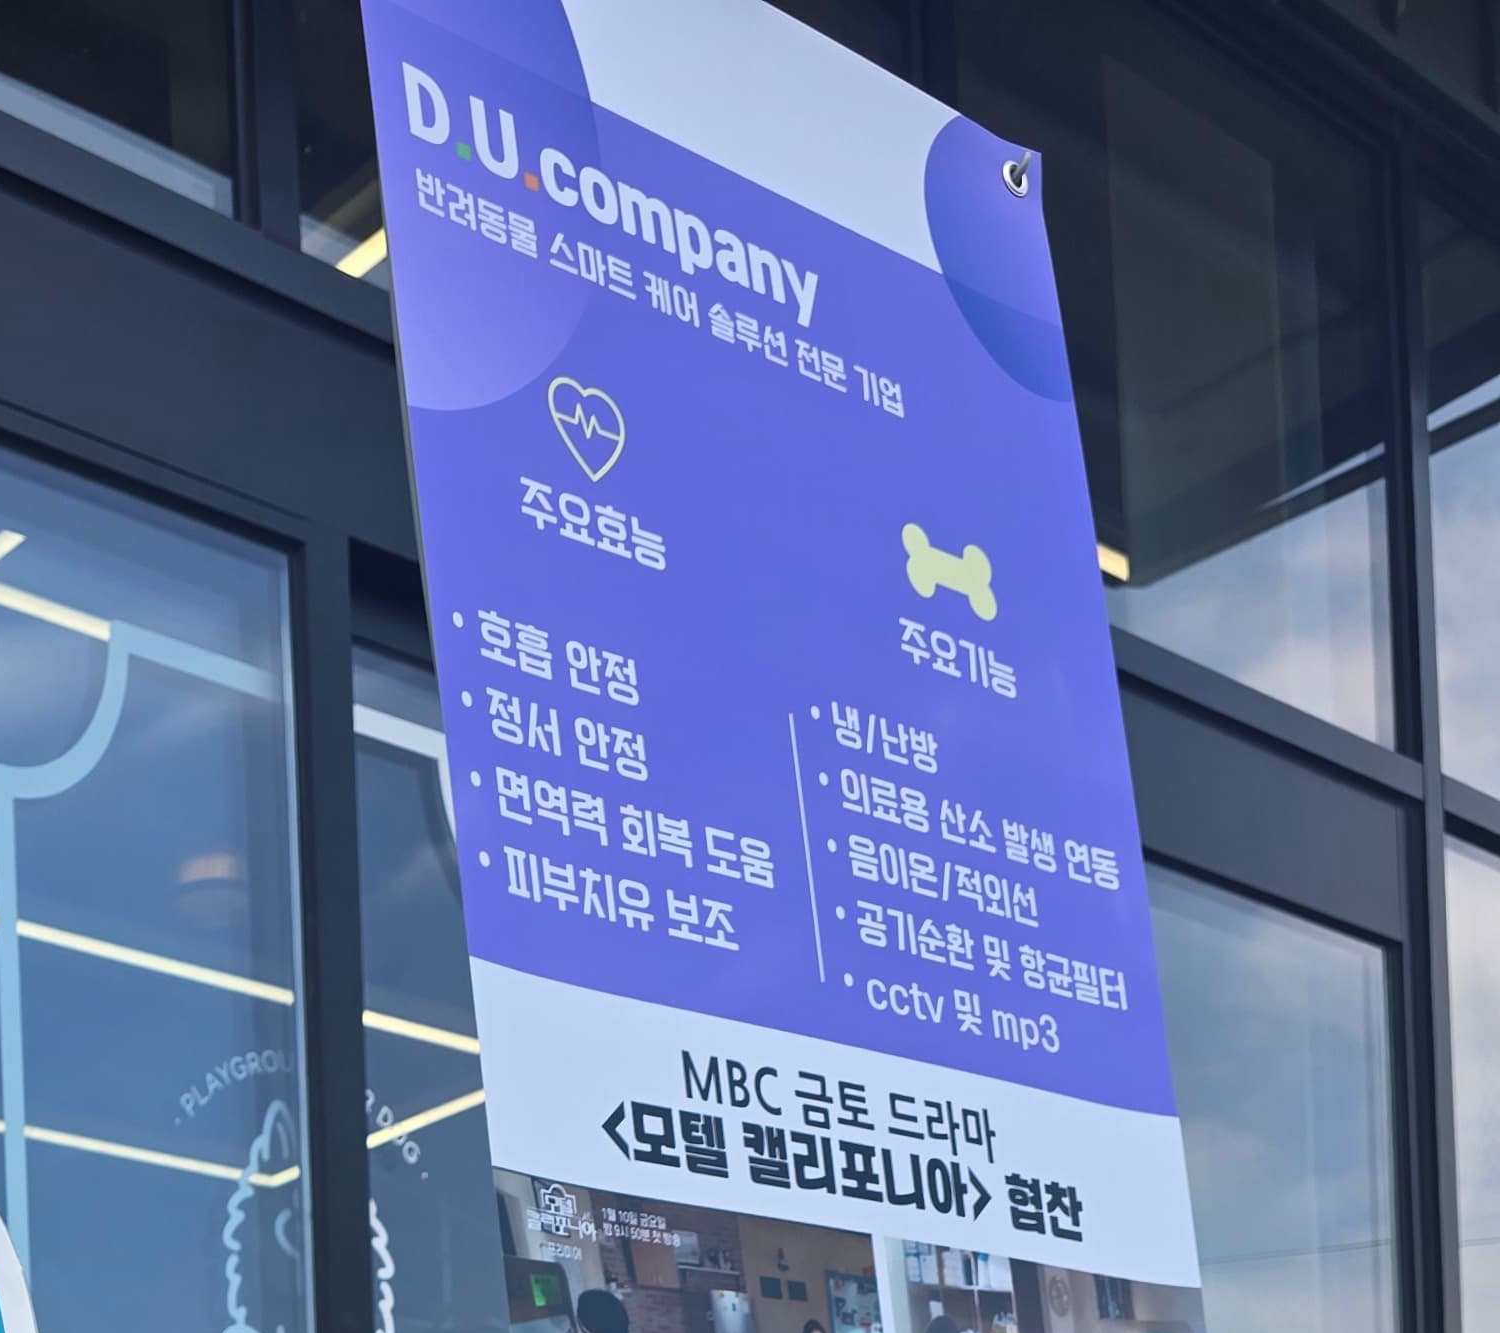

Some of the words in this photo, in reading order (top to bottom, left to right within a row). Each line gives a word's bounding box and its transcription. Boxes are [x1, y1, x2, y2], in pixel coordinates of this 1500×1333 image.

[401, 61, 818, 327] D.U.company
[414, 167, 539, 258] 반려동물
[549, 231, 636, 302] 스마트
[644, 274, 701, 328] 케어
[708, 302, 788, 366] 솔루션
[794, 338, 847, 392] 전문
[853, 362, 905, 418] 기업
[519, 476, 667, 570] 주요효능
[477, 609, 554, 681] 호흡
[565, 640, 640, 707] 안정
[900, 617, 1018, 699] 주요기능
[485, 686, 560, 758] 정서
[574, 715, 649, 782] 안정
[830, 701, 939, 774] 냉/난방
[496, 767, 609, 846] 면역력
[620, 803, 693, 868] 회복
[705, 827, 775, 890] 도움
[839, 769, 930, 834] 의료용
[939, 800, 996, 854] 산소
[1001, 819, 1058, 874] 발생
[1063, 837, 1121, 891] 연동
[504, 845, 654, 932] 피부치유
[667, 891, 740, 952] 보조
[847, 834, 1039, 928] 음이온/적외선
[856, 901, 975, 972] 공기순환
[983, 939, 1012, 980] 및
[1018, 945, 1128, 1013] 항균필터
[866, 976, 945, 1025] cctv
[954, 989, 983, 1037] 및
[993, 1008, 1060, 1055] mp3
[180, 1049, 293, 1118] PLAYGROU
[682, 1050, 782, 1113] MBC
[794, 1070, 874, 1134] 금토
[888, 1093, 997, 1164] 드라마
[1003, 1171, 1084, 1242] 협찬
